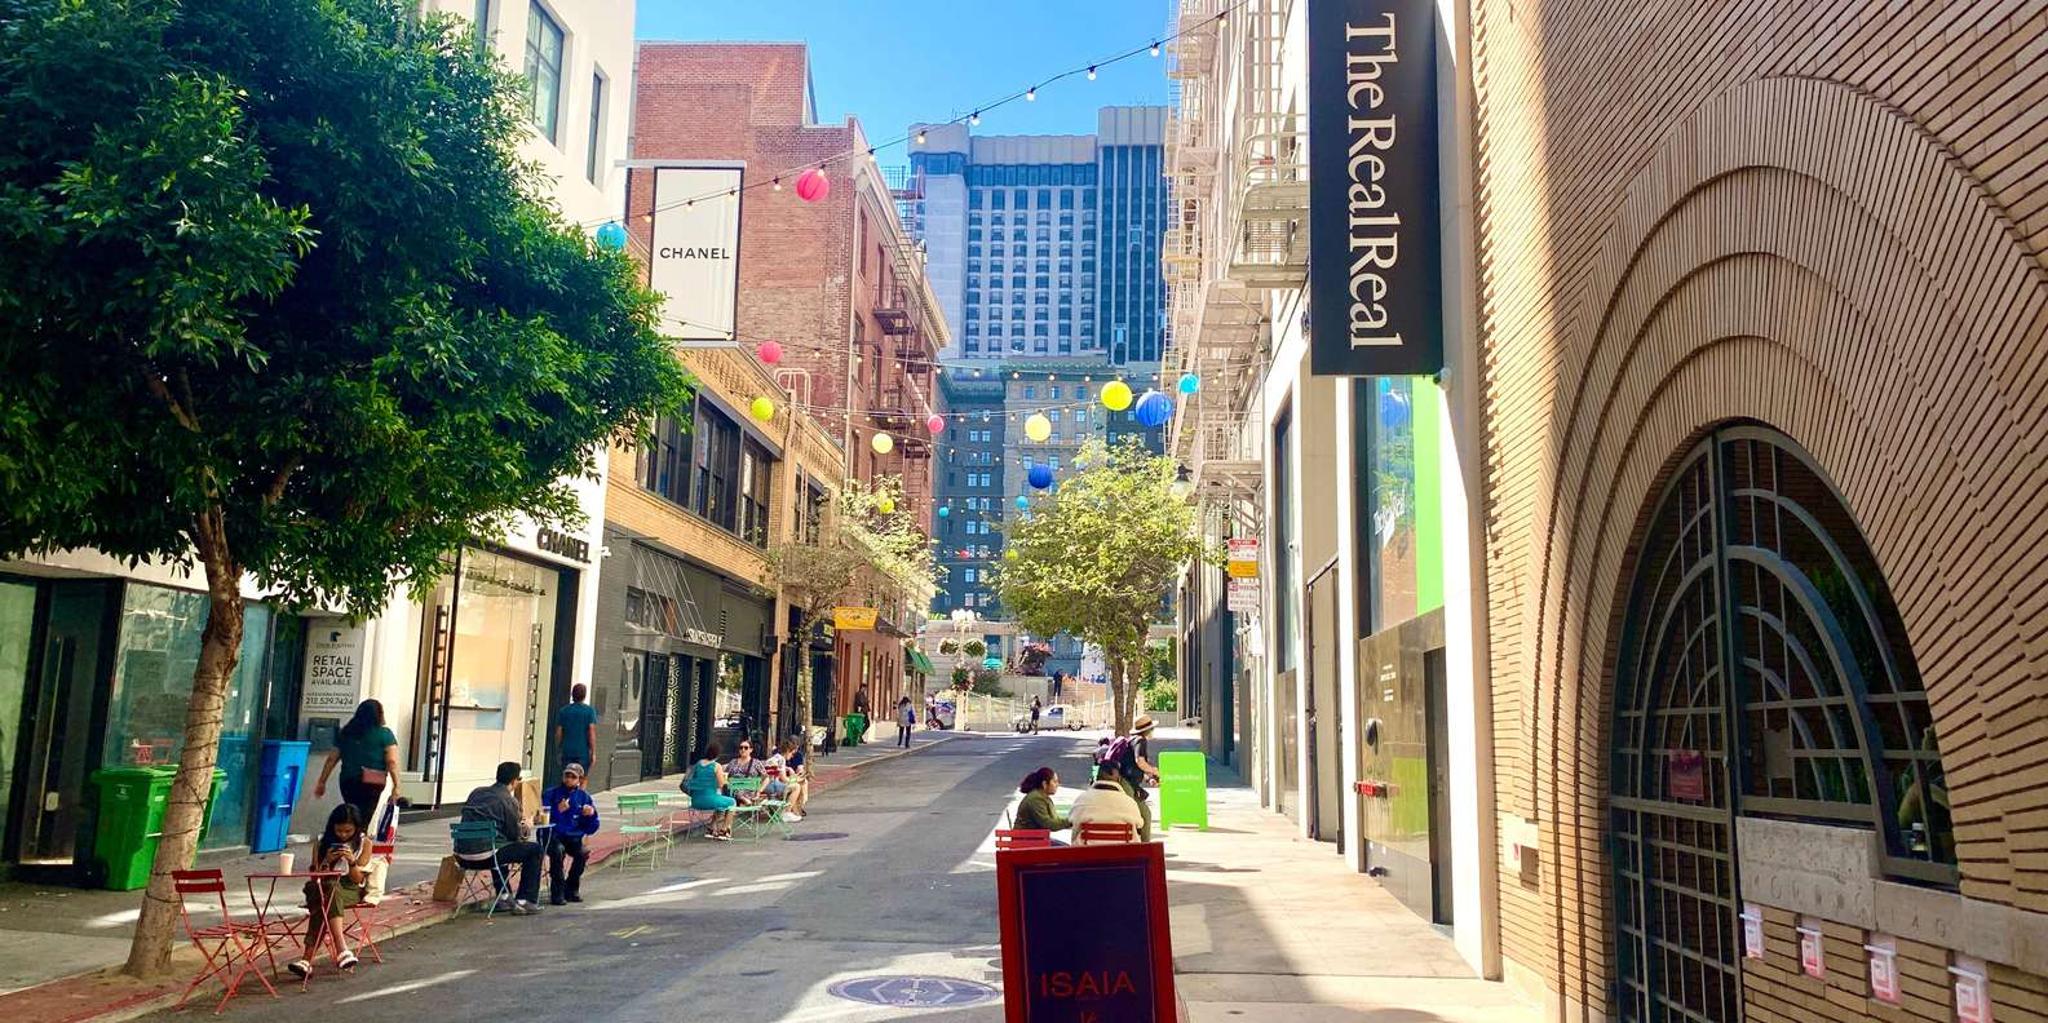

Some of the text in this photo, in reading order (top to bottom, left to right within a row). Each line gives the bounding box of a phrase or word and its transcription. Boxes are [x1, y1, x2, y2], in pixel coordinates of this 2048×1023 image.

[659, 247, 730, 260] CHANEL
[537, 529, 591, 563] CHANEL
[313, 655, 354, 665] RETAIL
[312, 667, 352, 677] SPACE
[1040, 970, 1136, 997] ISAIA
